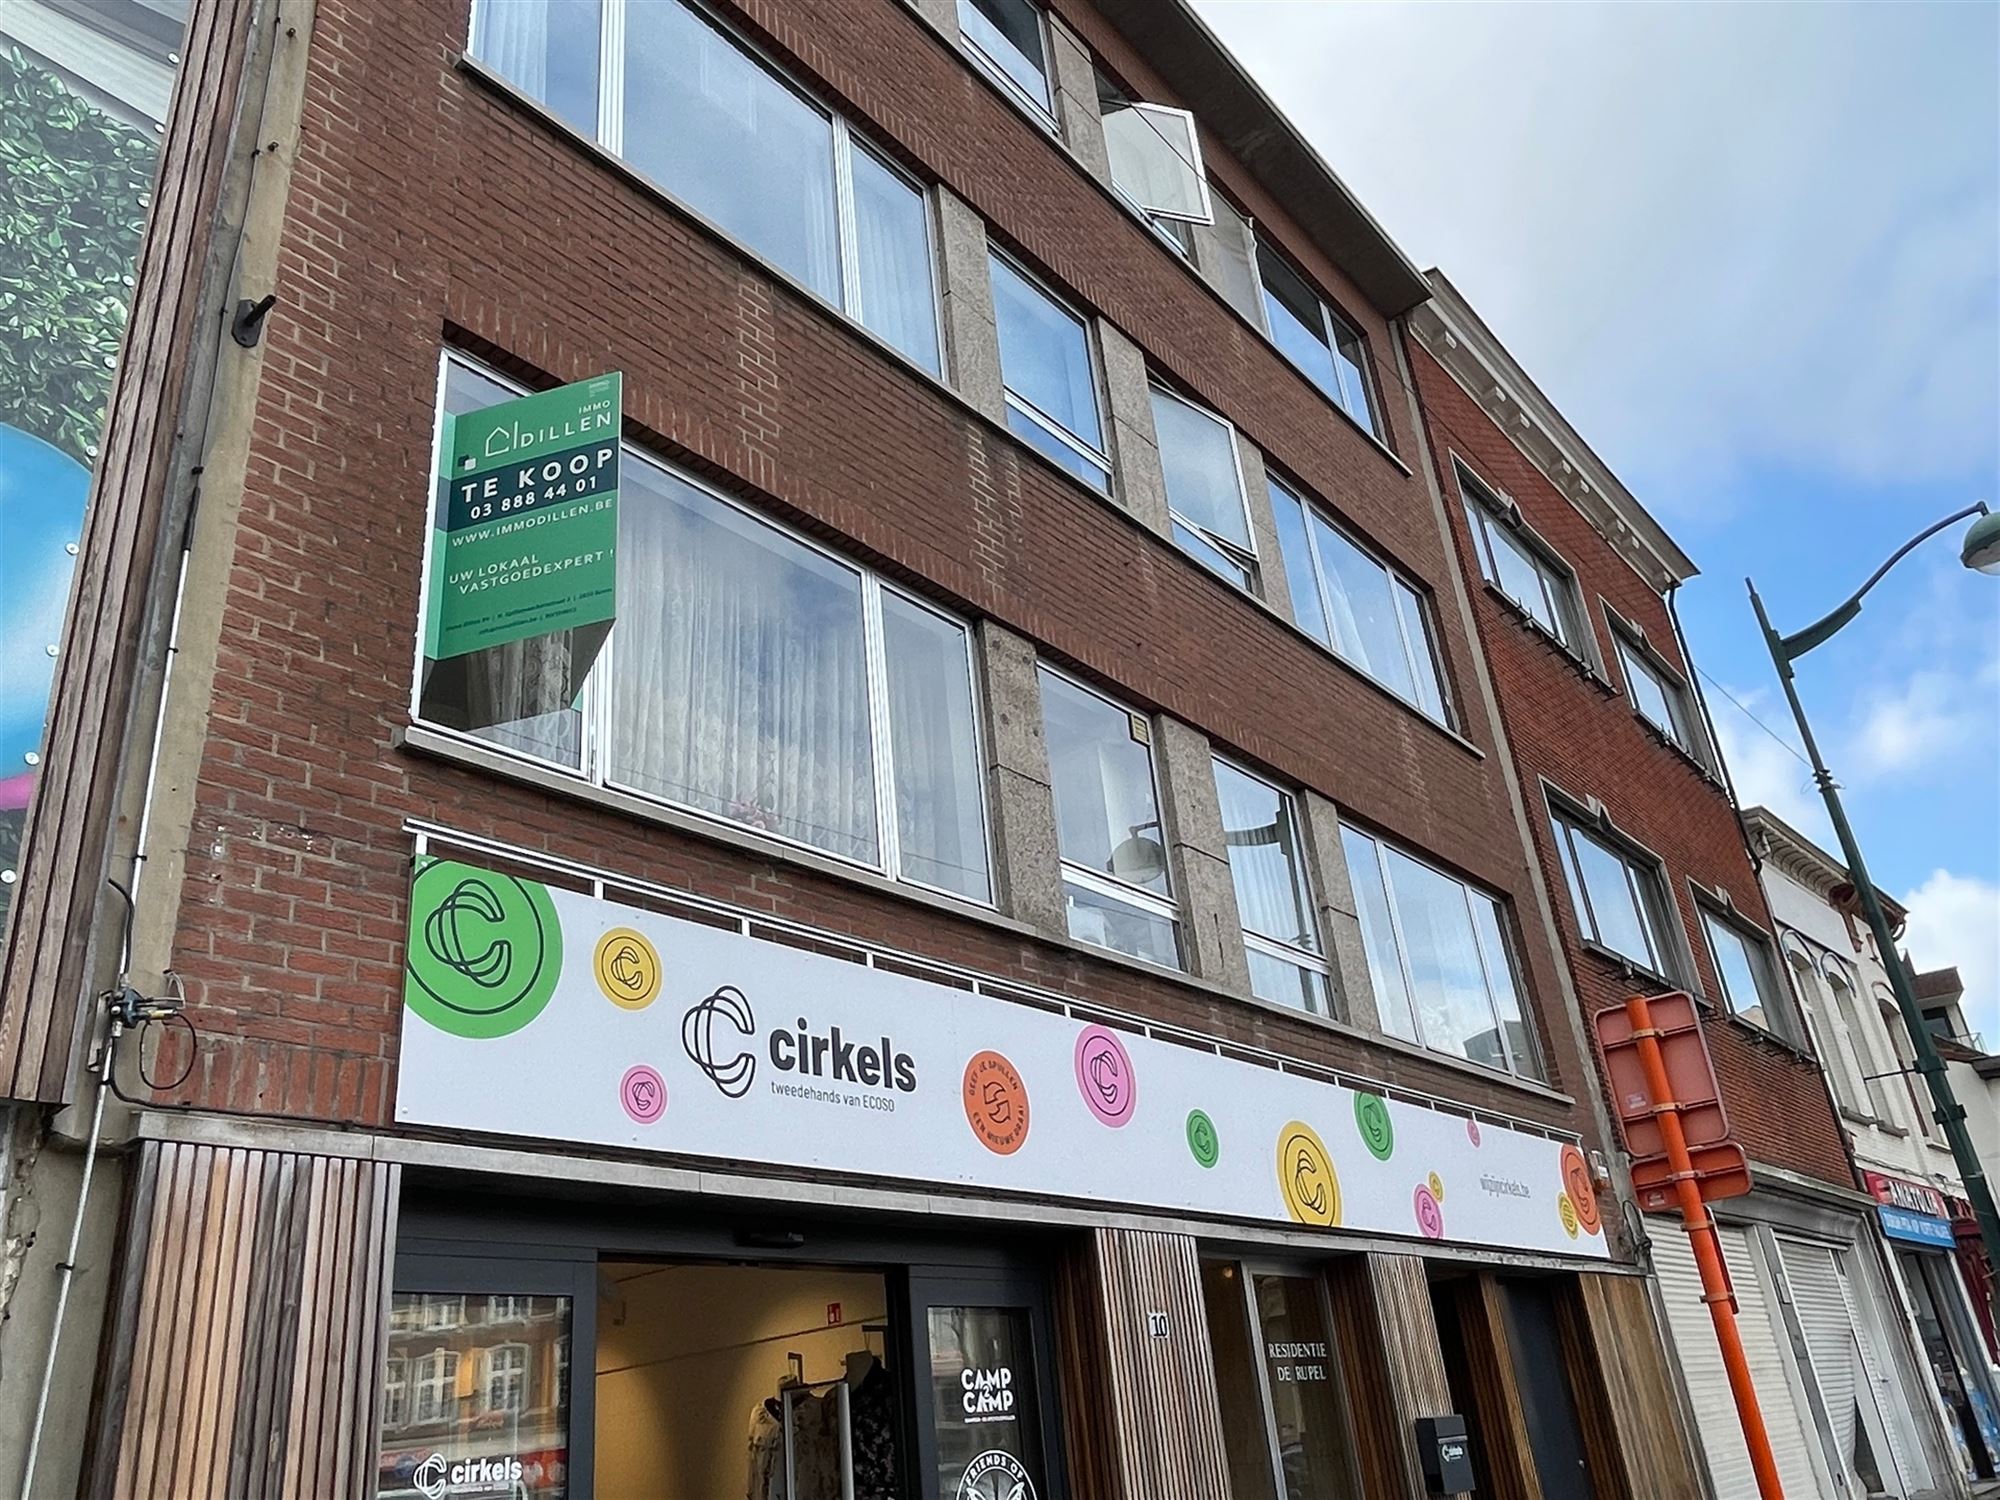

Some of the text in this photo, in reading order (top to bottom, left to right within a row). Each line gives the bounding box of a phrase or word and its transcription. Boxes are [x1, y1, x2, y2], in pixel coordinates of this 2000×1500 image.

[579, 400, 611, 415] IMMO
[520, 411, 612, 448] DILLEN
[461, 449, 613, 503] TE KOOP
[470, 476, 597, 520] 03 888 44 01
[452, 499, 613, 547] WWW.IMMODILLEN.BE
[449, 554, 539, 585] UW LOKAAL
[459, 551, 604, 595] VASTGOEDEXPERT
[769, 1017, 917, 1093] cirkels
[771, 1081, 895, 1112] tweedehands van ECOSO
[1151, 1315, 1168, 1337] 10
[1268, 1342, 1327, 1358] RESIDENTIE
[961, 1367, 1012, 1391] CAMP
[1277, 1365, 1327, 1381] DE RUPEL
[962, 1390, 1014, 1413] CAMP
[451, 1457, 524, 1484] cirkels
[965, 1454, 1024, 1487] FRIENDS OF
